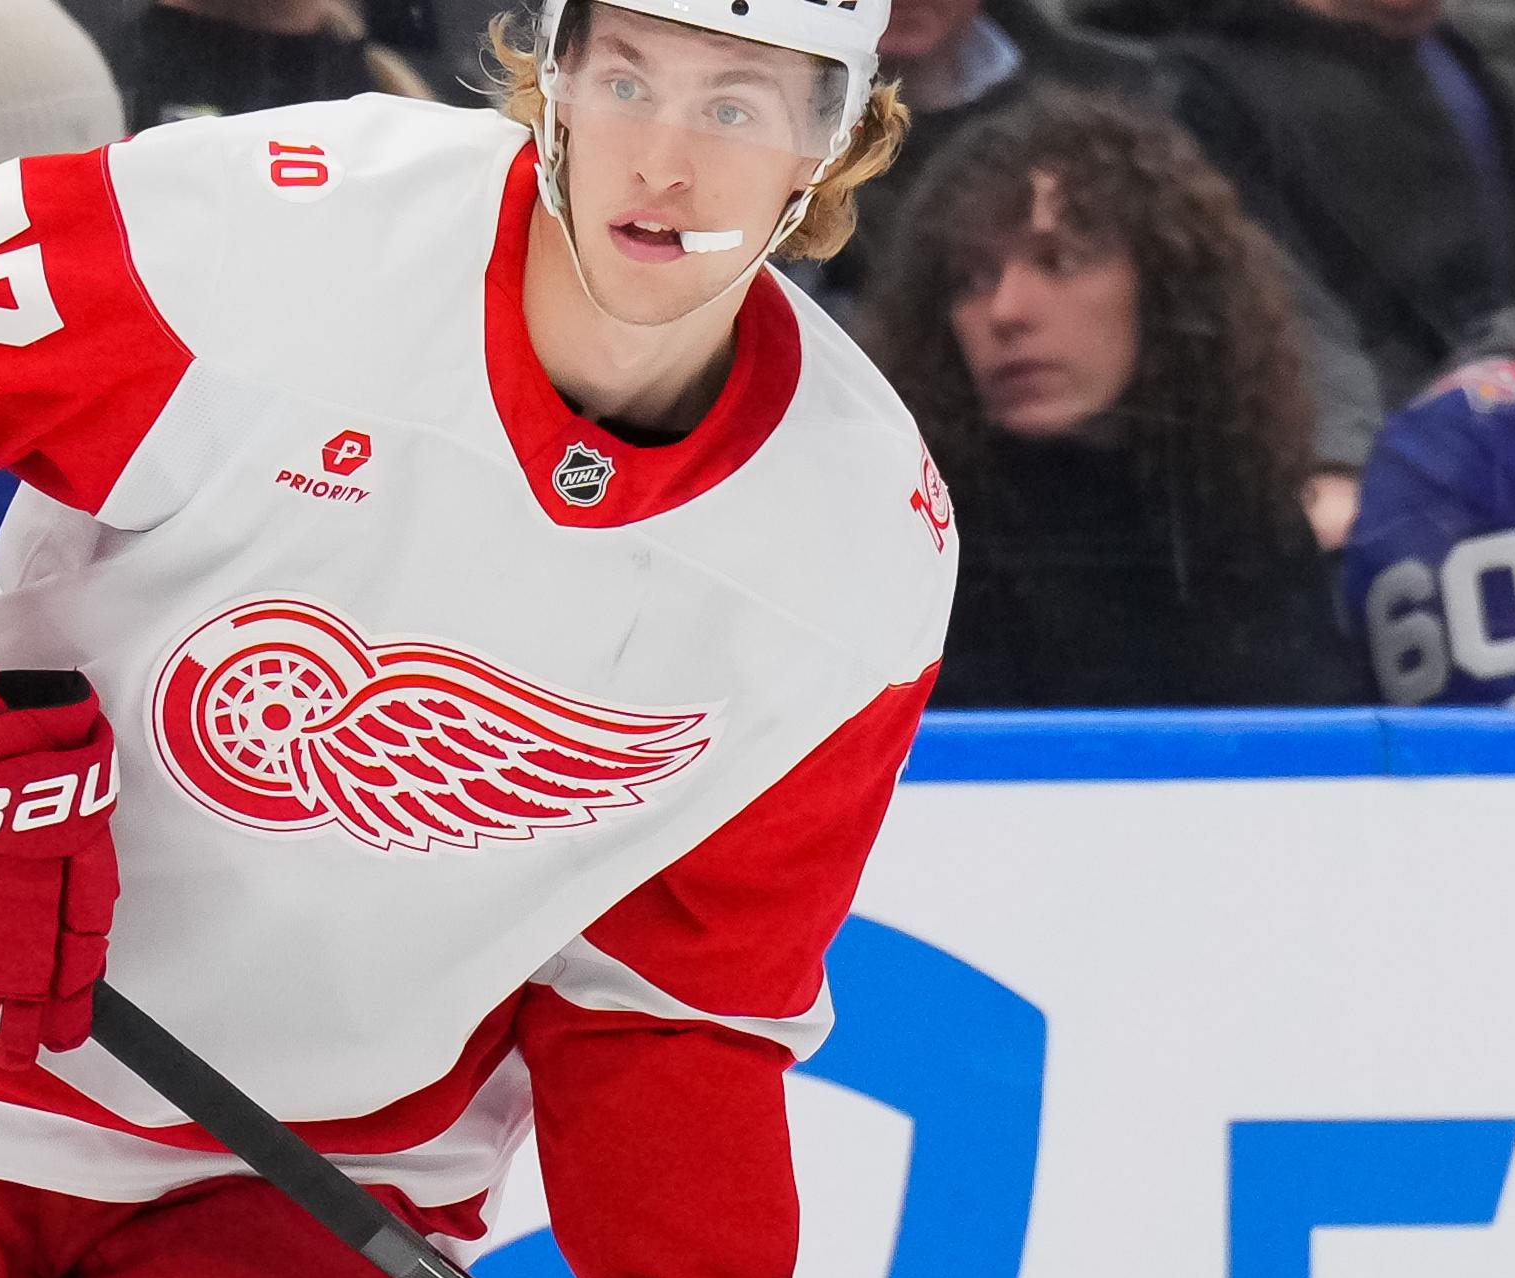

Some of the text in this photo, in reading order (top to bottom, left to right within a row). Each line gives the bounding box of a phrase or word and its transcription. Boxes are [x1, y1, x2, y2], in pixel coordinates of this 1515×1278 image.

[269, 140, 328, 187] 10
[275, 469, 371, 503] PRIORITY
[562, 468, 601, 486] NHL
